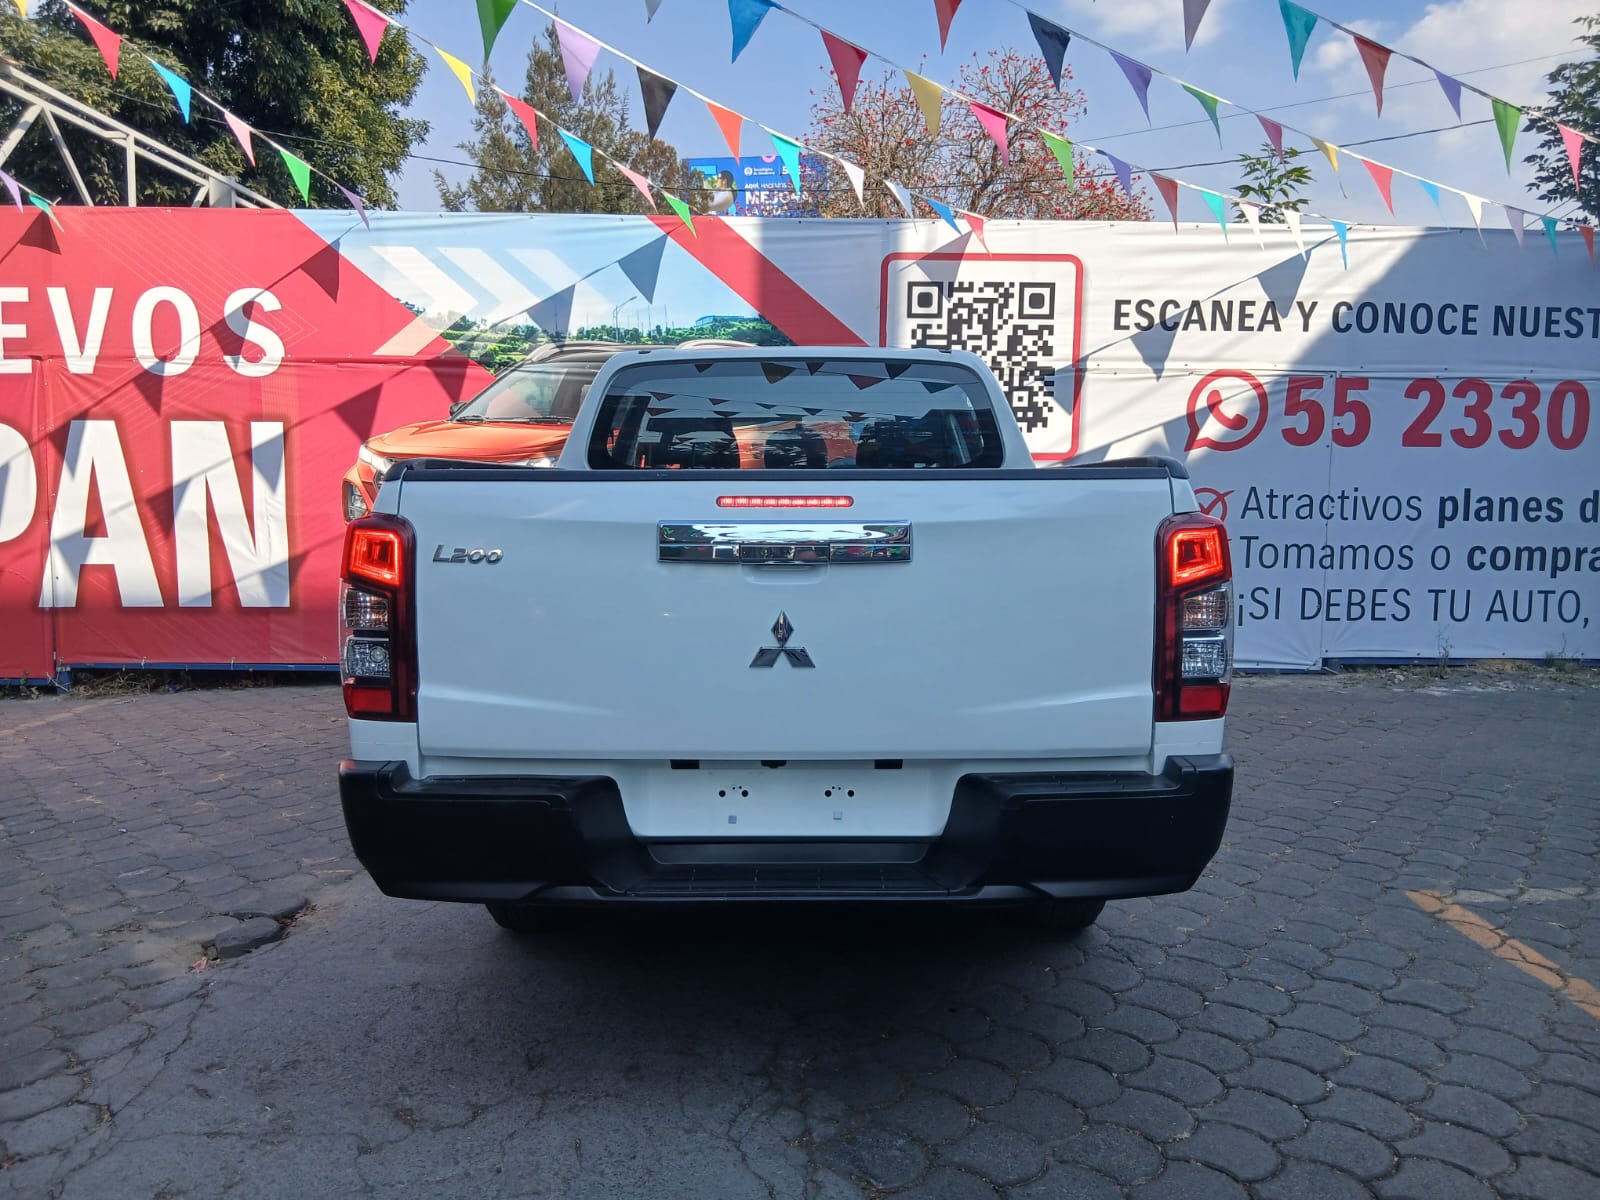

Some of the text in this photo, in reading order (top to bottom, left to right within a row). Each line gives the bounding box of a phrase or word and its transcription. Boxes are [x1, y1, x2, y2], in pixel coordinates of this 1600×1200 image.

[0, 286, 285, 377] EVOS
[1114, 300, 1600, 338] ESCANEA Y CONOCE NUEST
[1281, 377, 1590, 450] 55 2330
[1240, 486, 1599, 528] Atractivos planes d
[432, 544, 504, 565] L200
[1239, 536, 1600, 579] Tomamos o compra
[1238, 587, 1589, 629] ¡SI DEBES TU AUTO,
